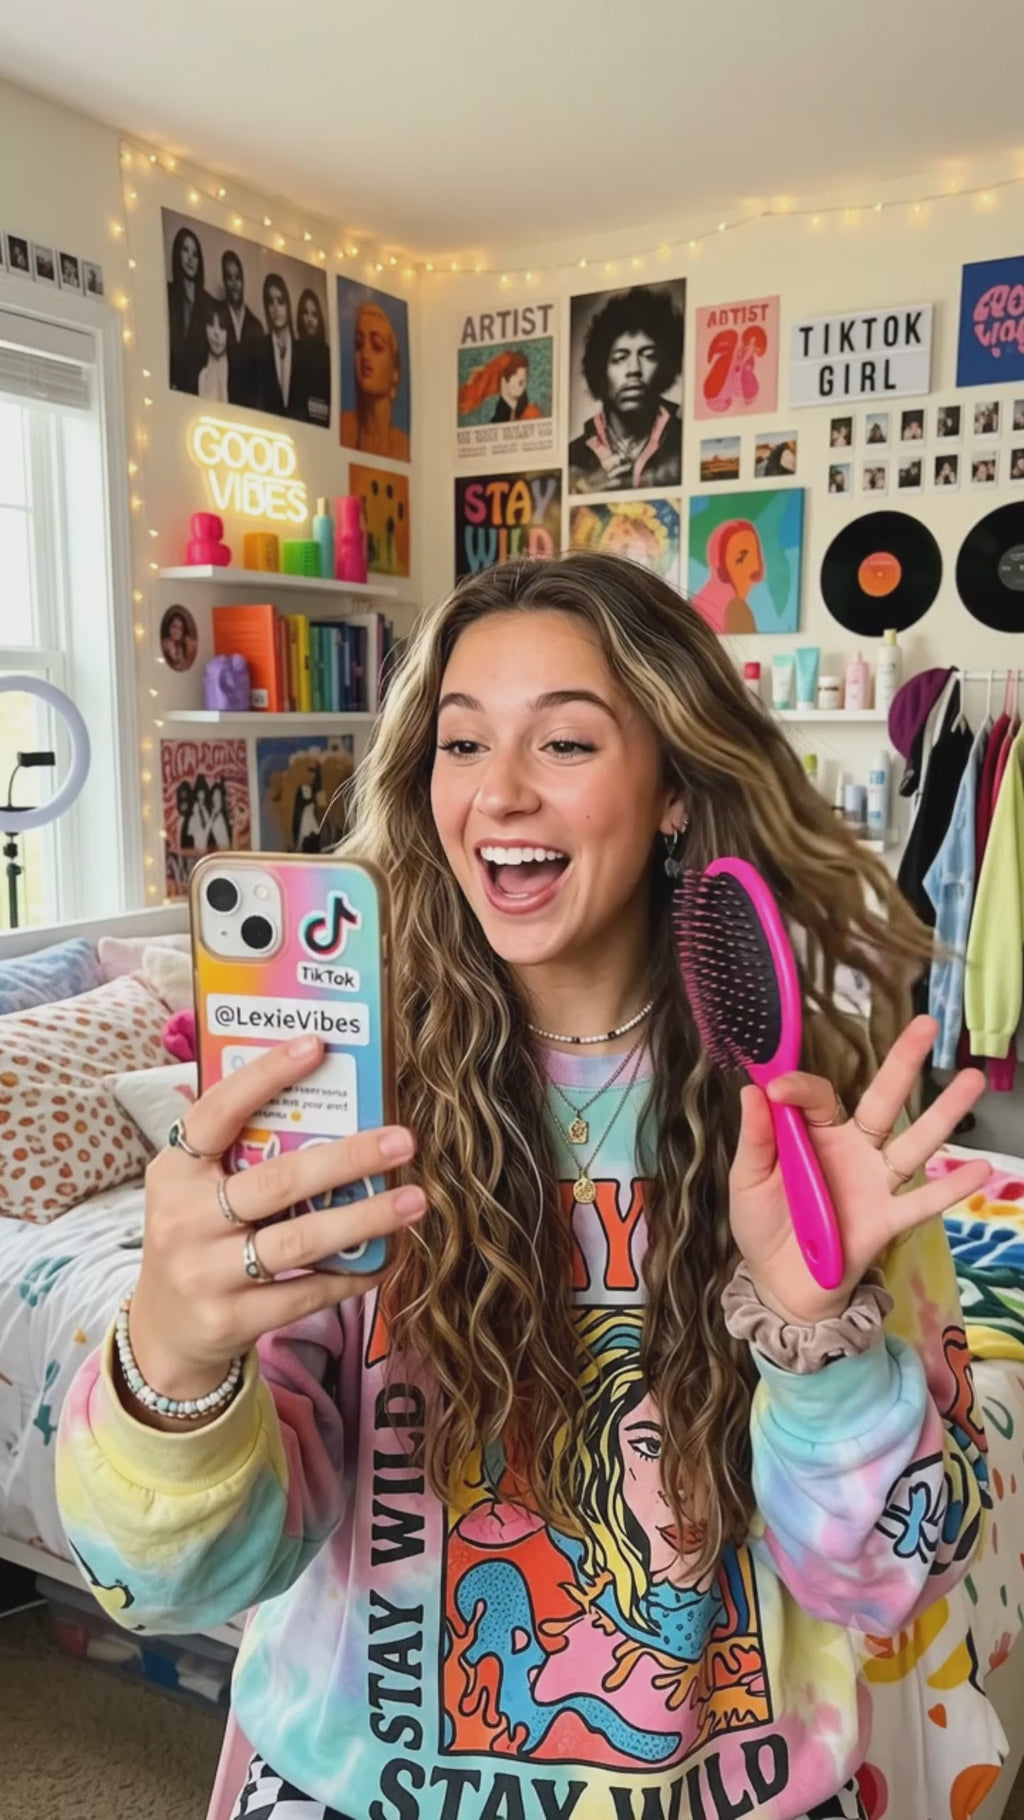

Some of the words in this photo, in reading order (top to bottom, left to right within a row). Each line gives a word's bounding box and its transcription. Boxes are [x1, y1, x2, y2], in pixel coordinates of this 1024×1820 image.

[461, 304, 554, 345] ARTIST
[799, 312, 922, 357] TIKTOK
[819, 359, 896, 396] GIRL
[193, 424, 297, 478] GOOD
[207, 468, 308, 523] VIBES
[464, 479, 557, 525] STAY
[464, 524, 554, 571] WILD
[301, 966, 356, 988] TikTok
[214, 1004, 361, 1034] @LexieVibes
[371, 1382, 426, 1567] WILD
[368, 1588, 424, 1751] STAY
[368, 1757, 588, 1820] STAY
